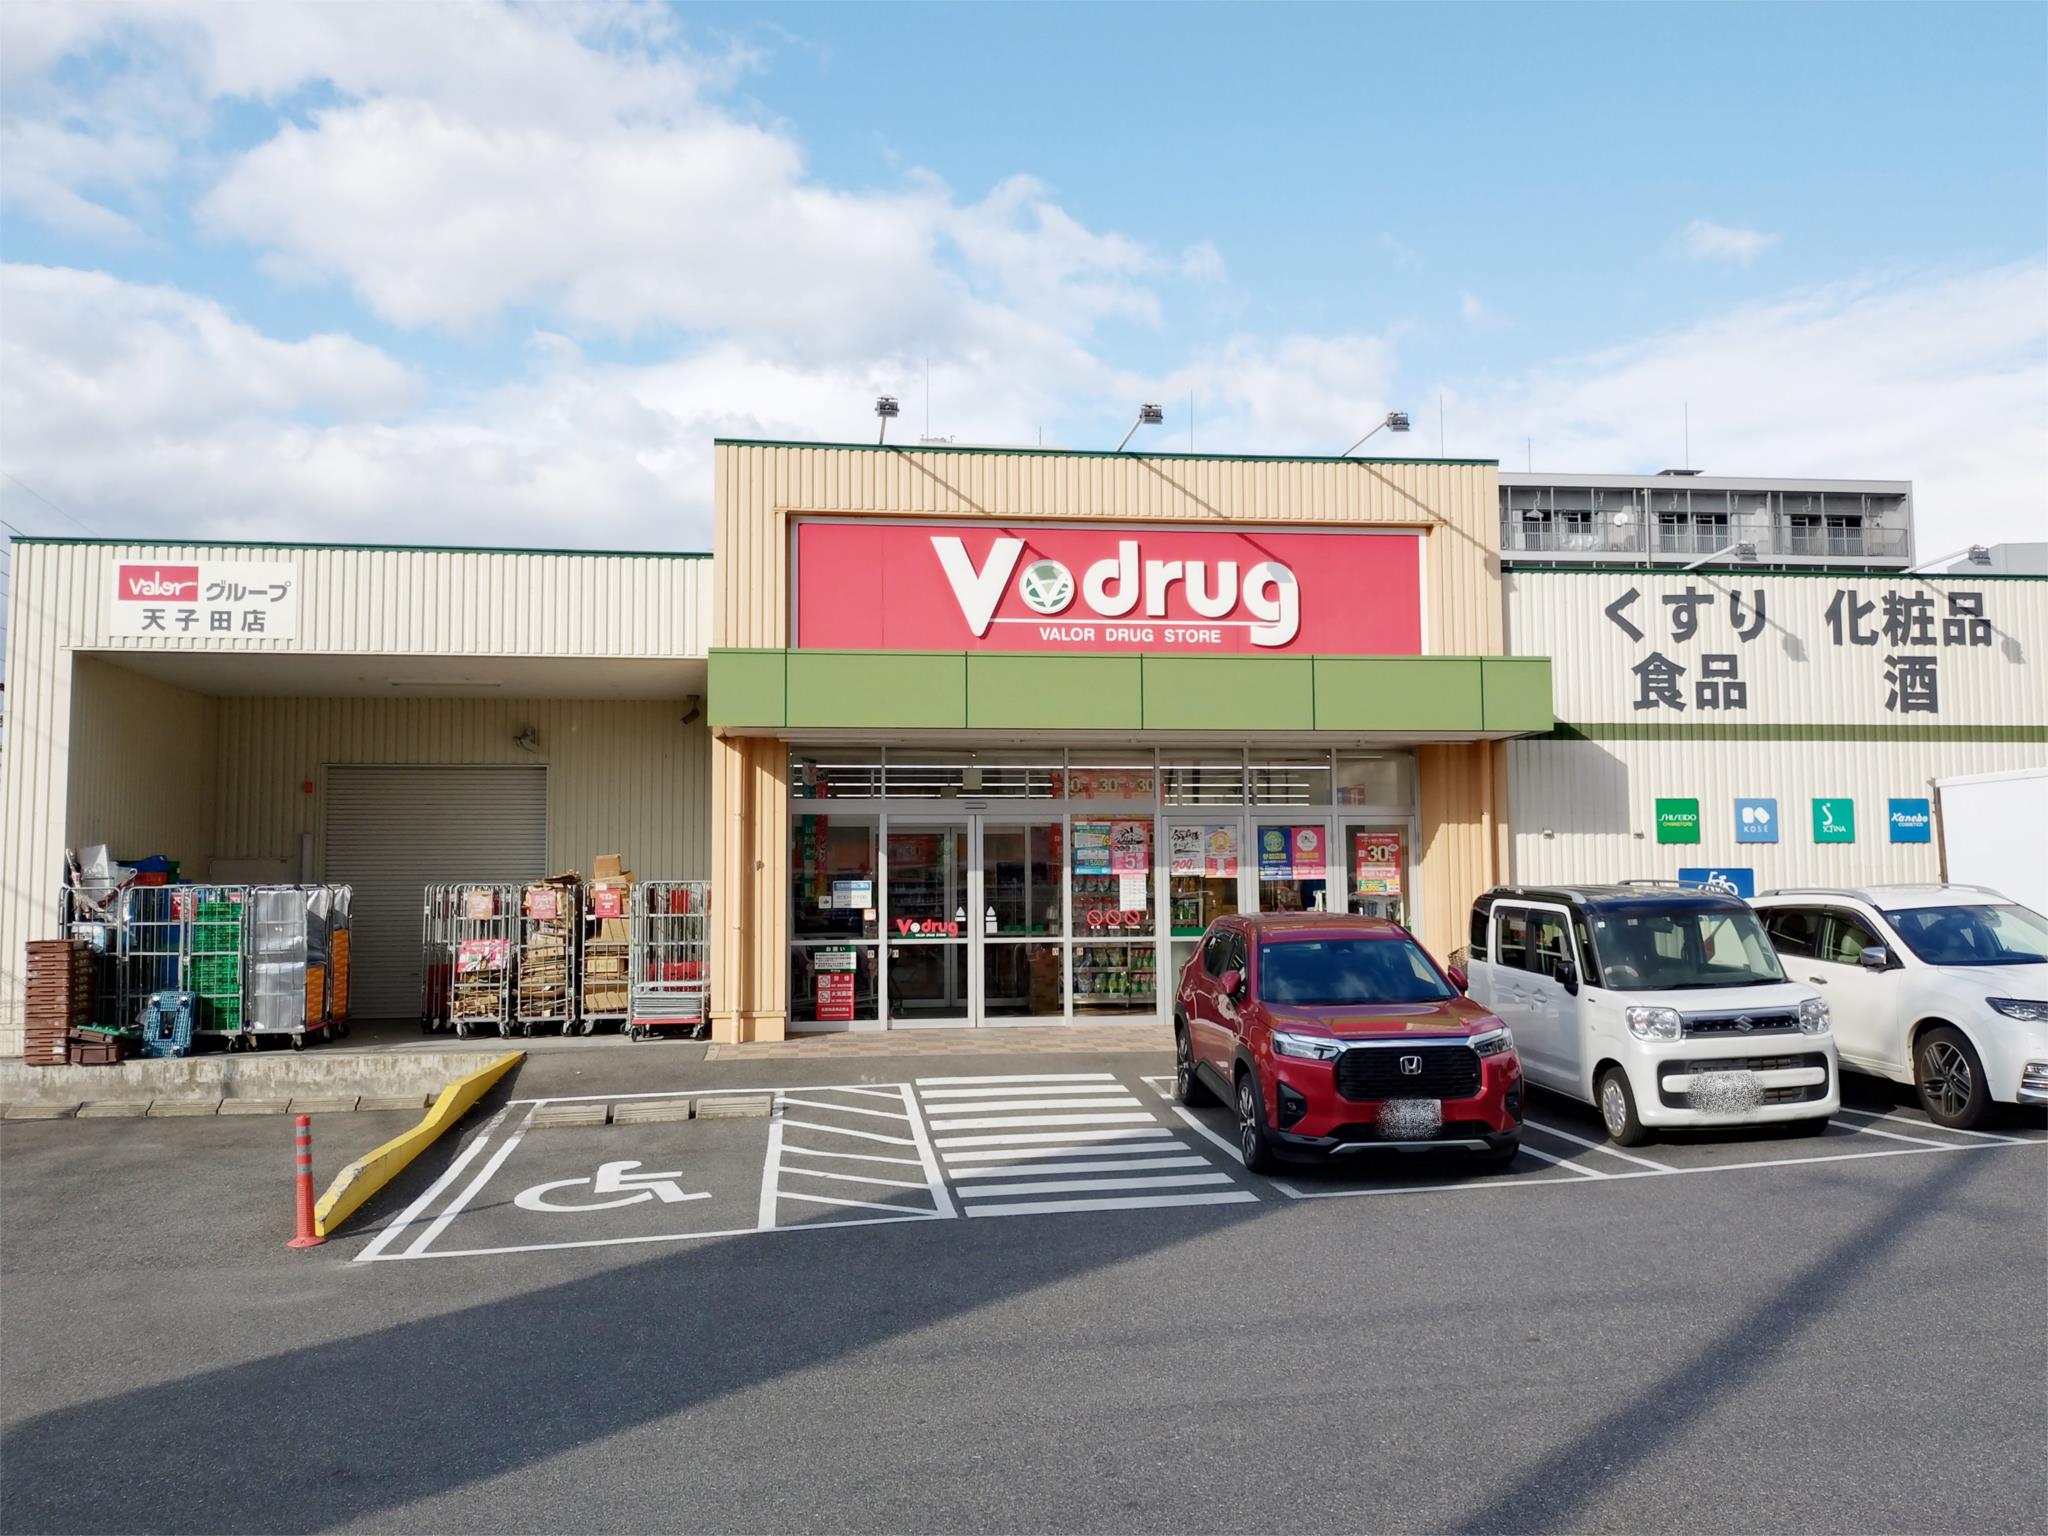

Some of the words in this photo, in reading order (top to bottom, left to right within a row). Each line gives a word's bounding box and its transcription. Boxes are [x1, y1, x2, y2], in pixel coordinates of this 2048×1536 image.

[129, 571, 197, 596] valor
[206, 580, 292, 602] グループ
[141, 608, 266, 633] 天子田店
[1604, 586, 1767, 643] くすり
[1824, 589, 1992, 646] 化粧品
[1039, 627, 1095, 642] VALOR
[1106, 628, 1154, 643] DRUG
[1164, 629, 1222, 643] STORE
[1631, 651, 1747, 712] 食品
[1883, 654, 1938, 714] 酒
[1658, 813, 1697, 821] SHISEIDO
[1891, 812, 1928, 822] Kanebo
[1367, 845, 1389, 862] 30
